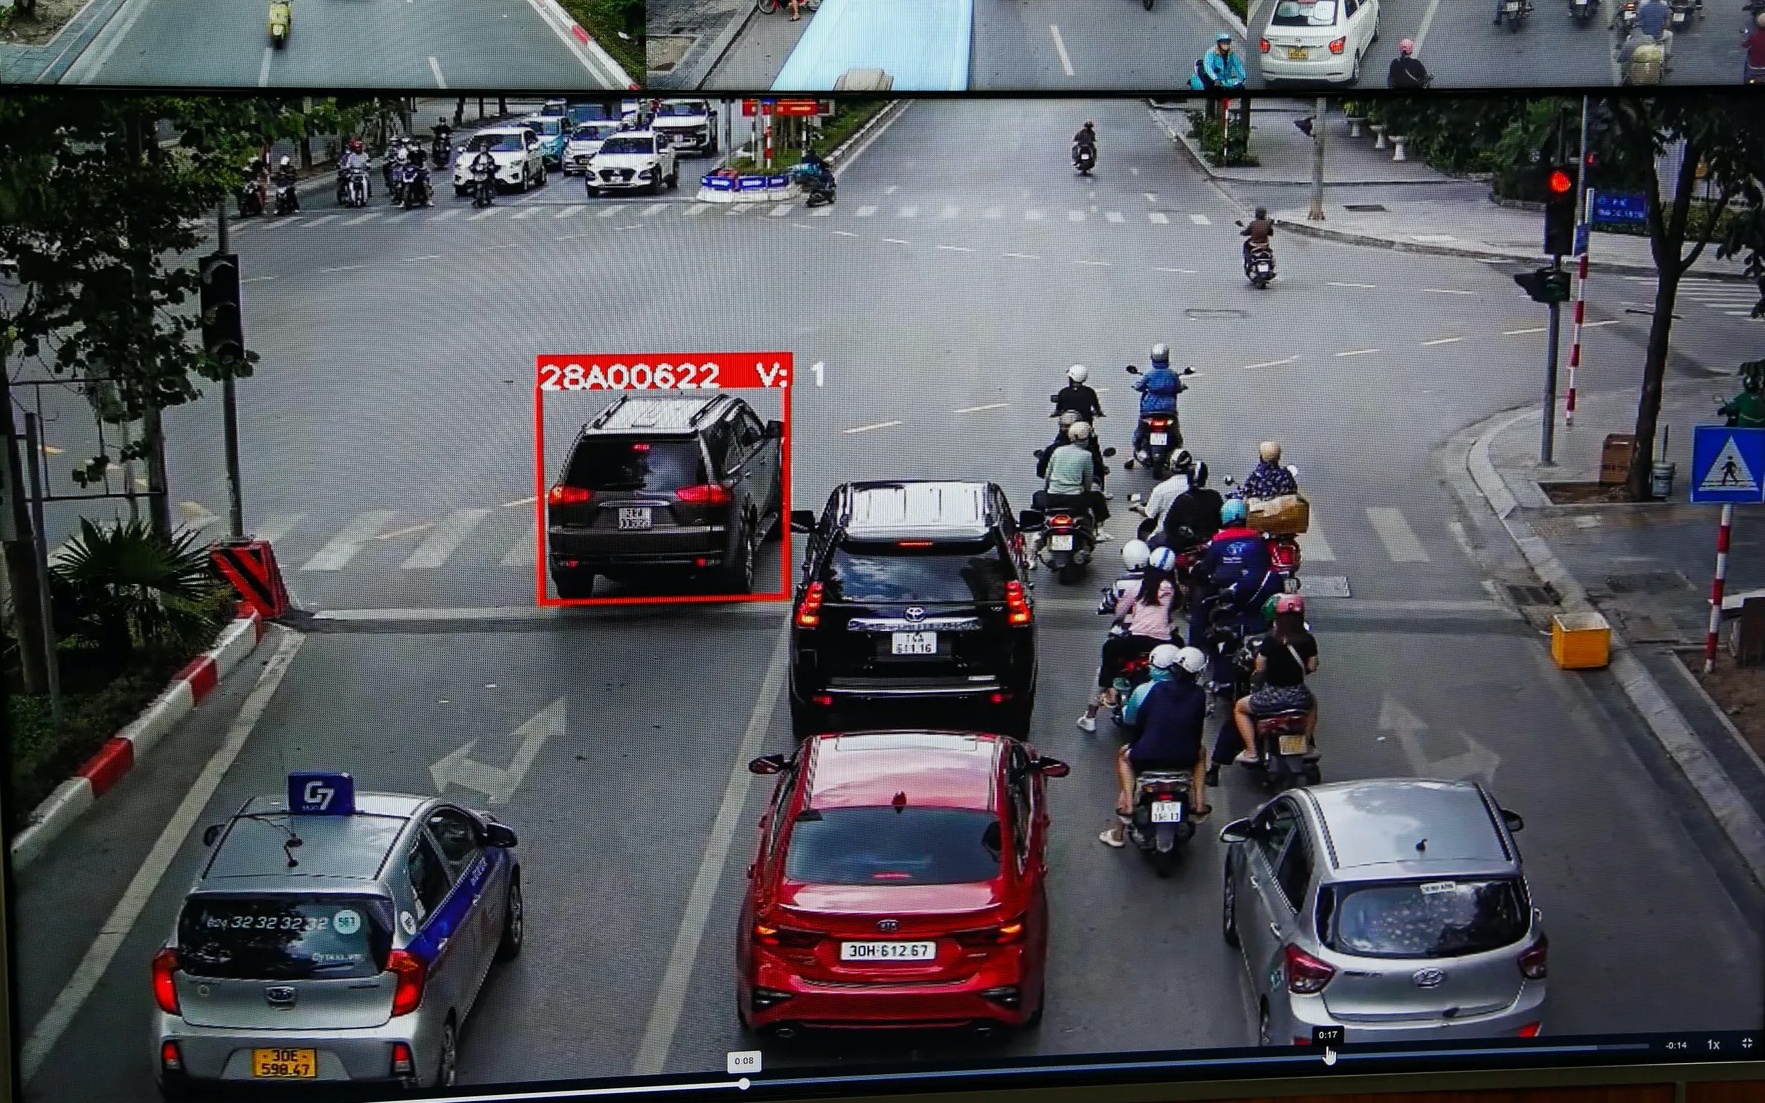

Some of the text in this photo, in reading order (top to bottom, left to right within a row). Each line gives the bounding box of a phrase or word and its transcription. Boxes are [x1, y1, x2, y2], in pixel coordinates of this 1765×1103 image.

[540, 360, 824, 390] 28A00622 V: 1
[303, 780, 335, 811] G7
[230, 915, 254, 929] 32
[255, 916, 279, 930] 32
[279, 916, 303, 930] 32
[305, 916, 329, 931] 32
[1318, 1030, 1338, 1040] 0:17
[1665, 1041, 1687, 1050] -0:14
[1707, 1039, 1720, 1050] 1x
[272, 1049, 298, 1062] 30E
[734, 1056, 754, 1065] 0:08
[261, 1063, 310, 1077] 598.47
